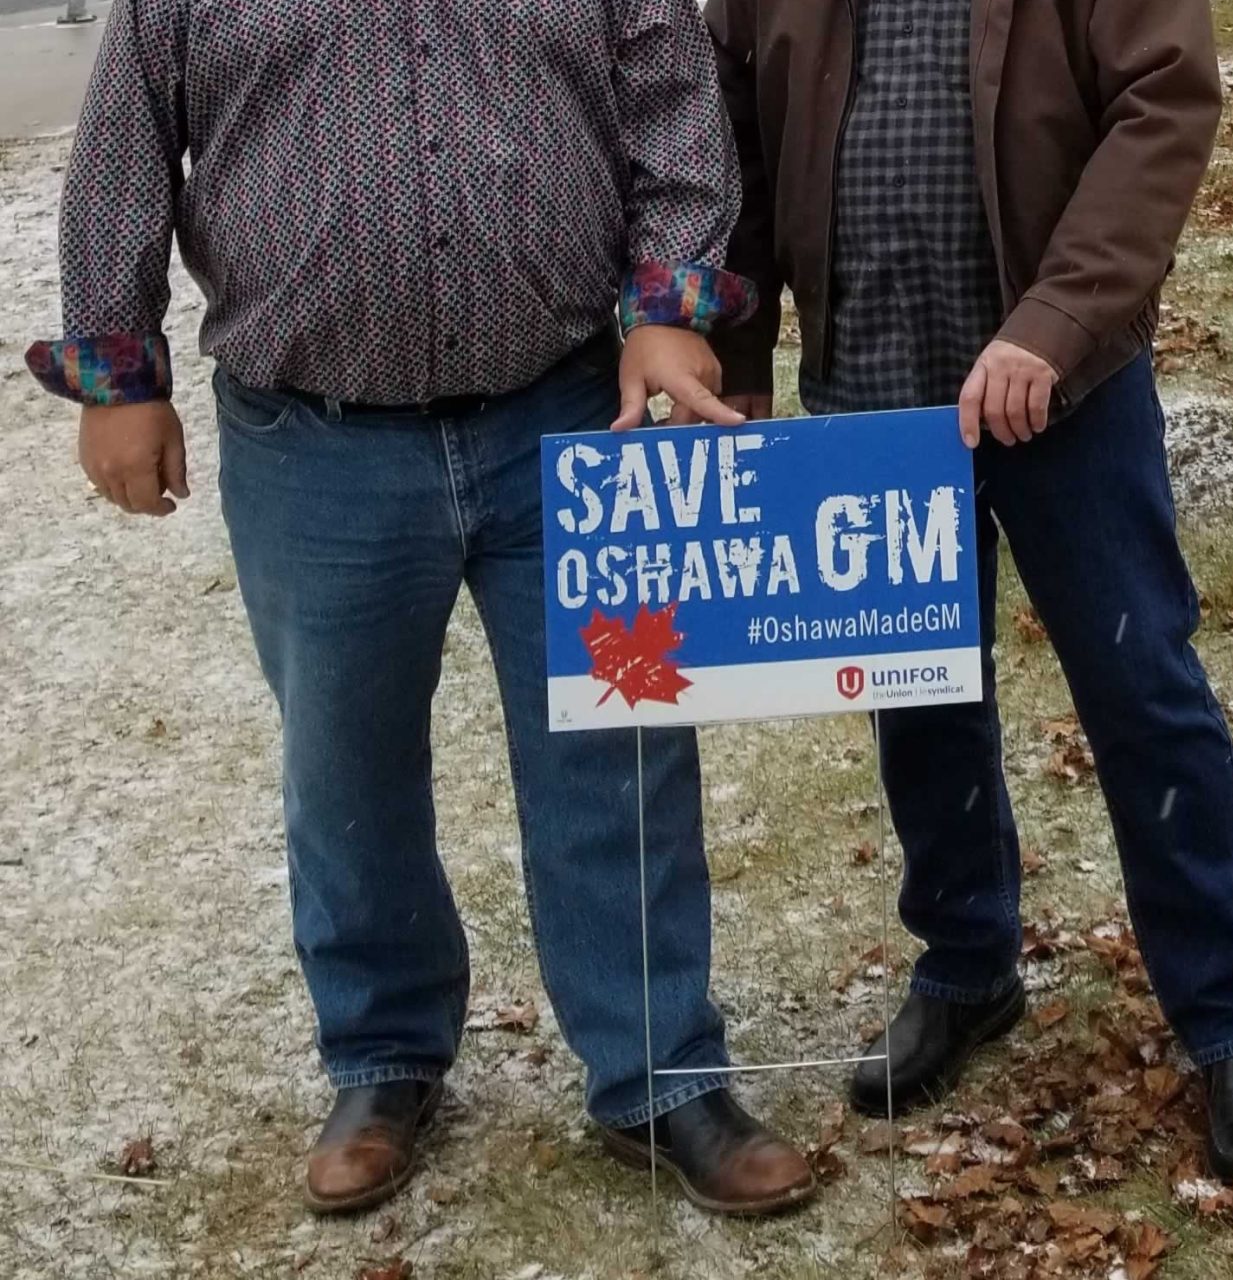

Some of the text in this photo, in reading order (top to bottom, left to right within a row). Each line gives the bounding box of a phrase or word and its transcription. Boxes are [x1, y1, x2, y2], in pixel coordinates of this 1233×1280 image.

[556, 434, 766, 534] SAVE
[557, 535, 800, 609] OSHAWA
[815, 487, 963, 592] GM
[747, 603, 961, 645] #OshawaMadeGM
